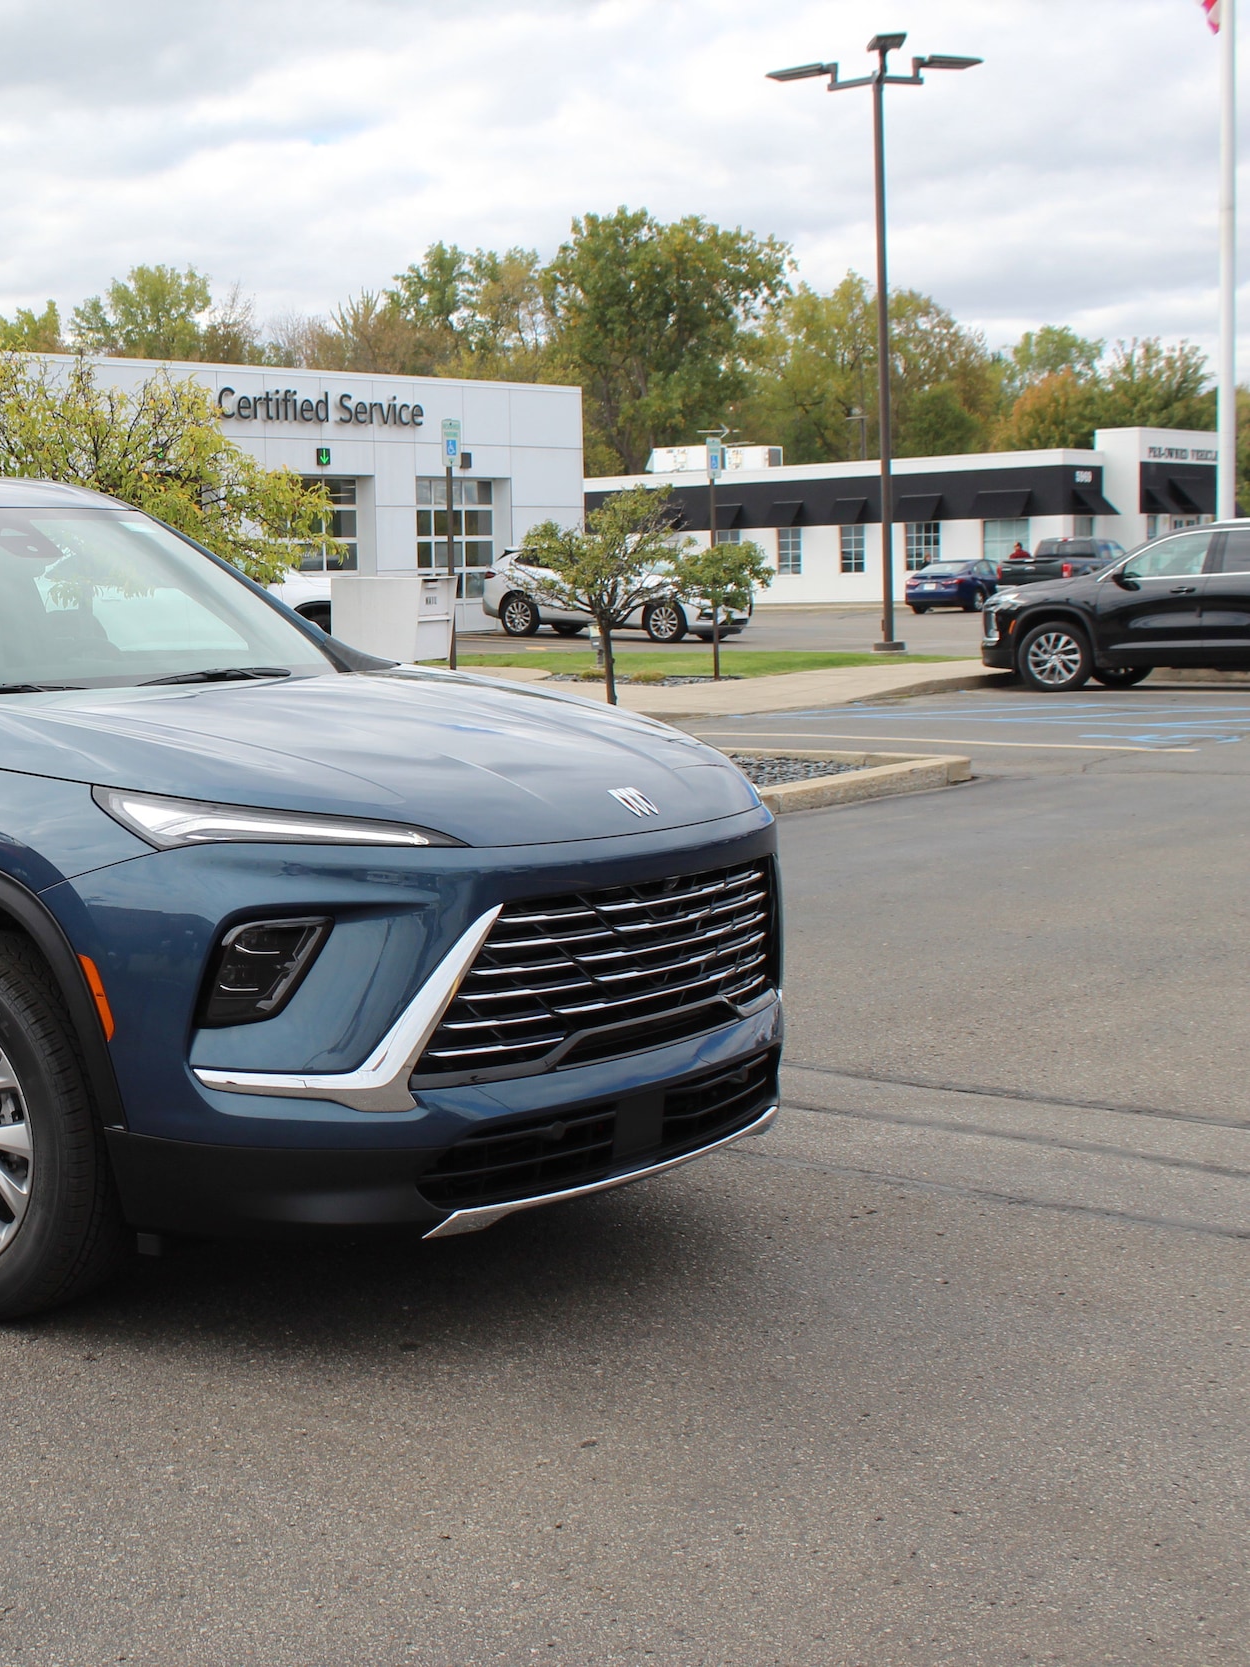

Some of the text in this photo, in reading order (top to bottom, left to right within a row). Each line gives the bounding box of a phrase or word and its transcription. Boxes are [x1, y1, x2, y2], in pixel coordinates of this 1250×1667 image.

[218, 386, 424, 426] Certified Service
[1190, 448, 1218, 462] VEHICL
